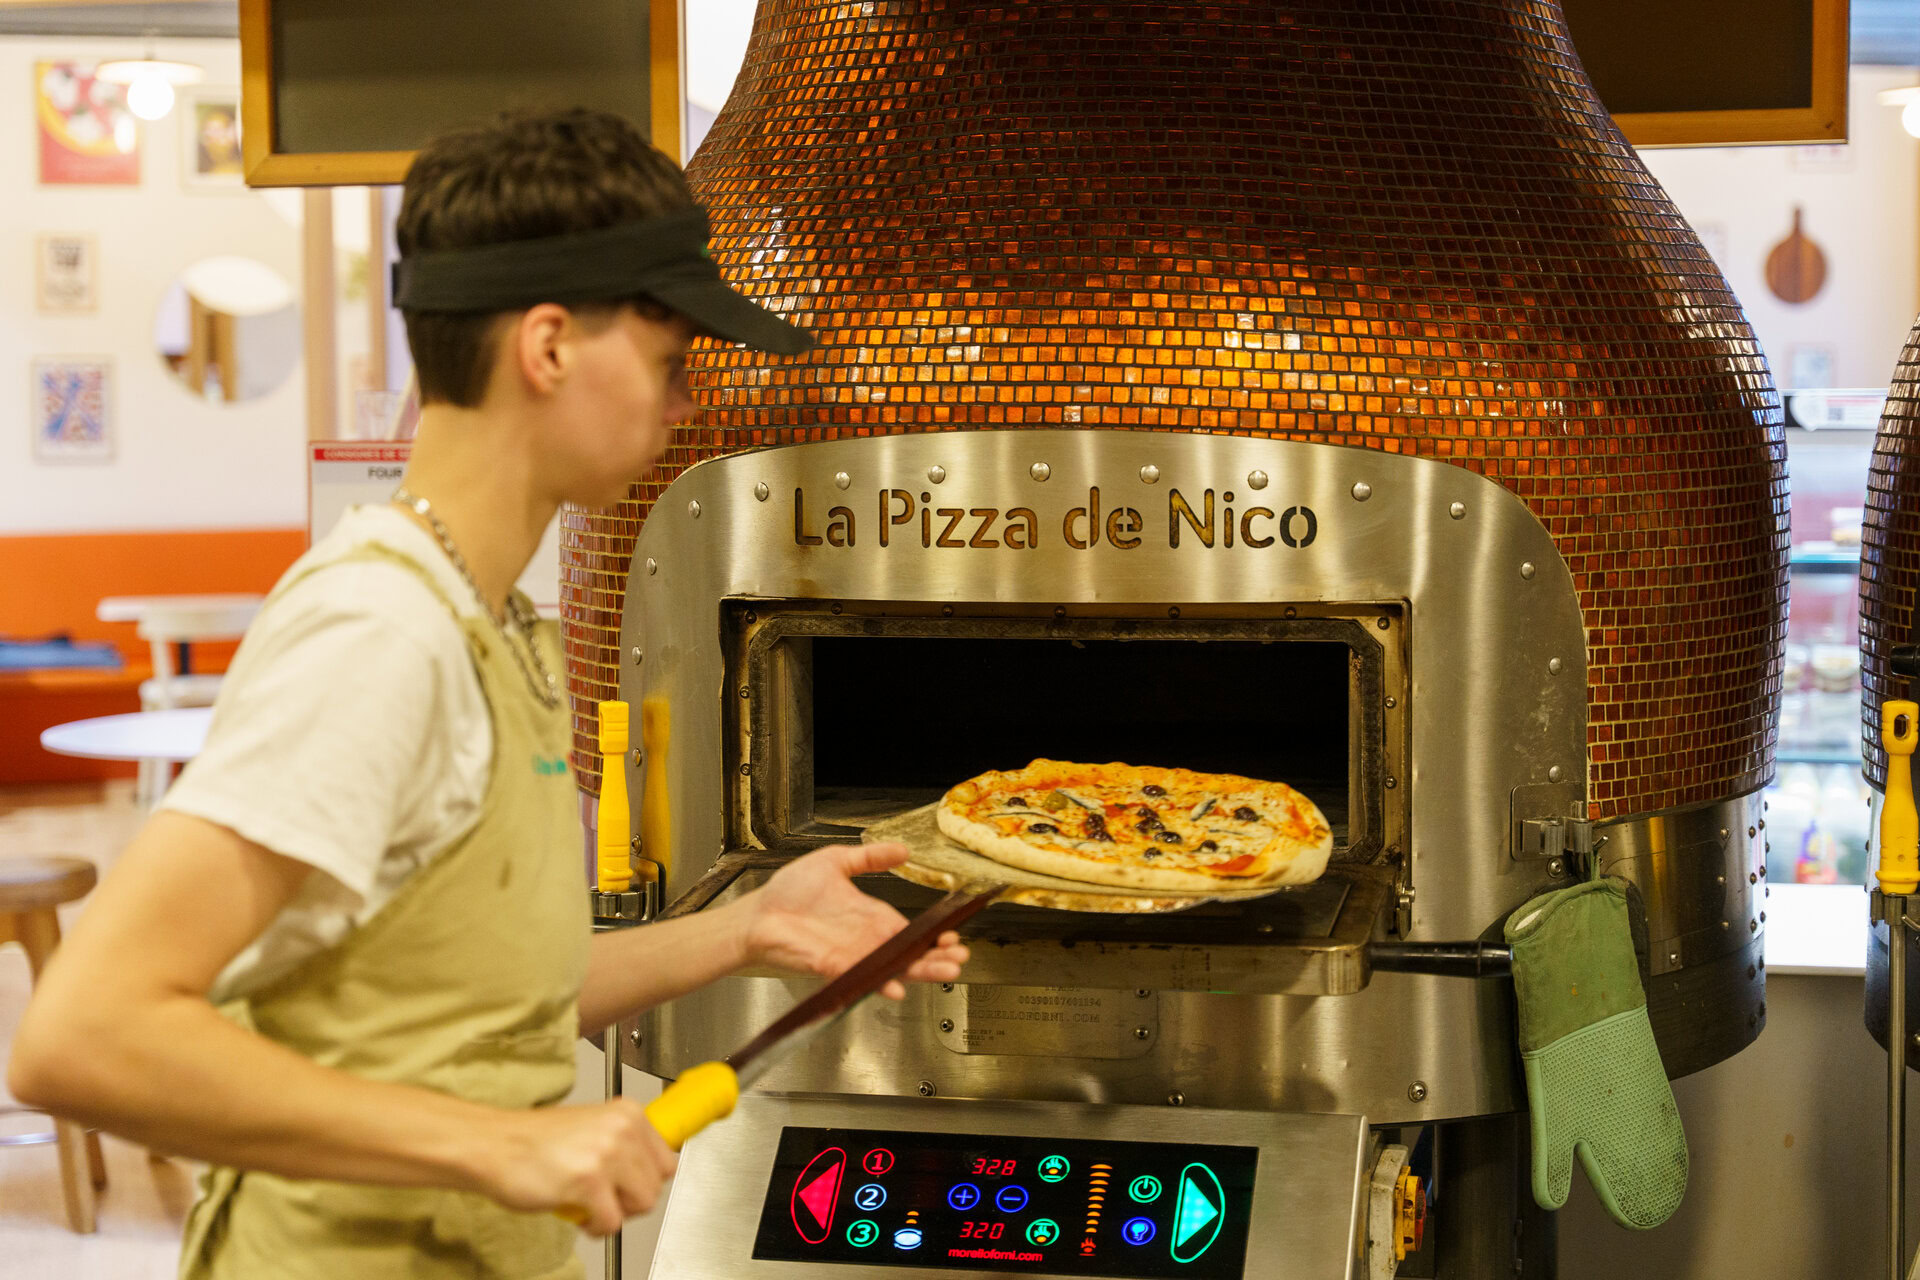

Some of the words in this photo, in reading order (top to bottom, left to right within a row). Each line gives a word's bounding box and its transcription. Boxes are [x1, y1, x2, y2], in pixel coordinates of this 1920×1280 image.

[368, 466, 403, 480] FOUR
[794, 487, 856, 548] La
[879, 488, 1039, 550] Pizza
[1063, 486, 1143, 550] de
[1169, 487, 1318, 550] Nico
[972, 1157, 1017, 1176] 328
[862, 1188, 879, 1207] 2
[854, 1224, 871, 1242] 3
[959, 1221, 1005, 1240] 320
